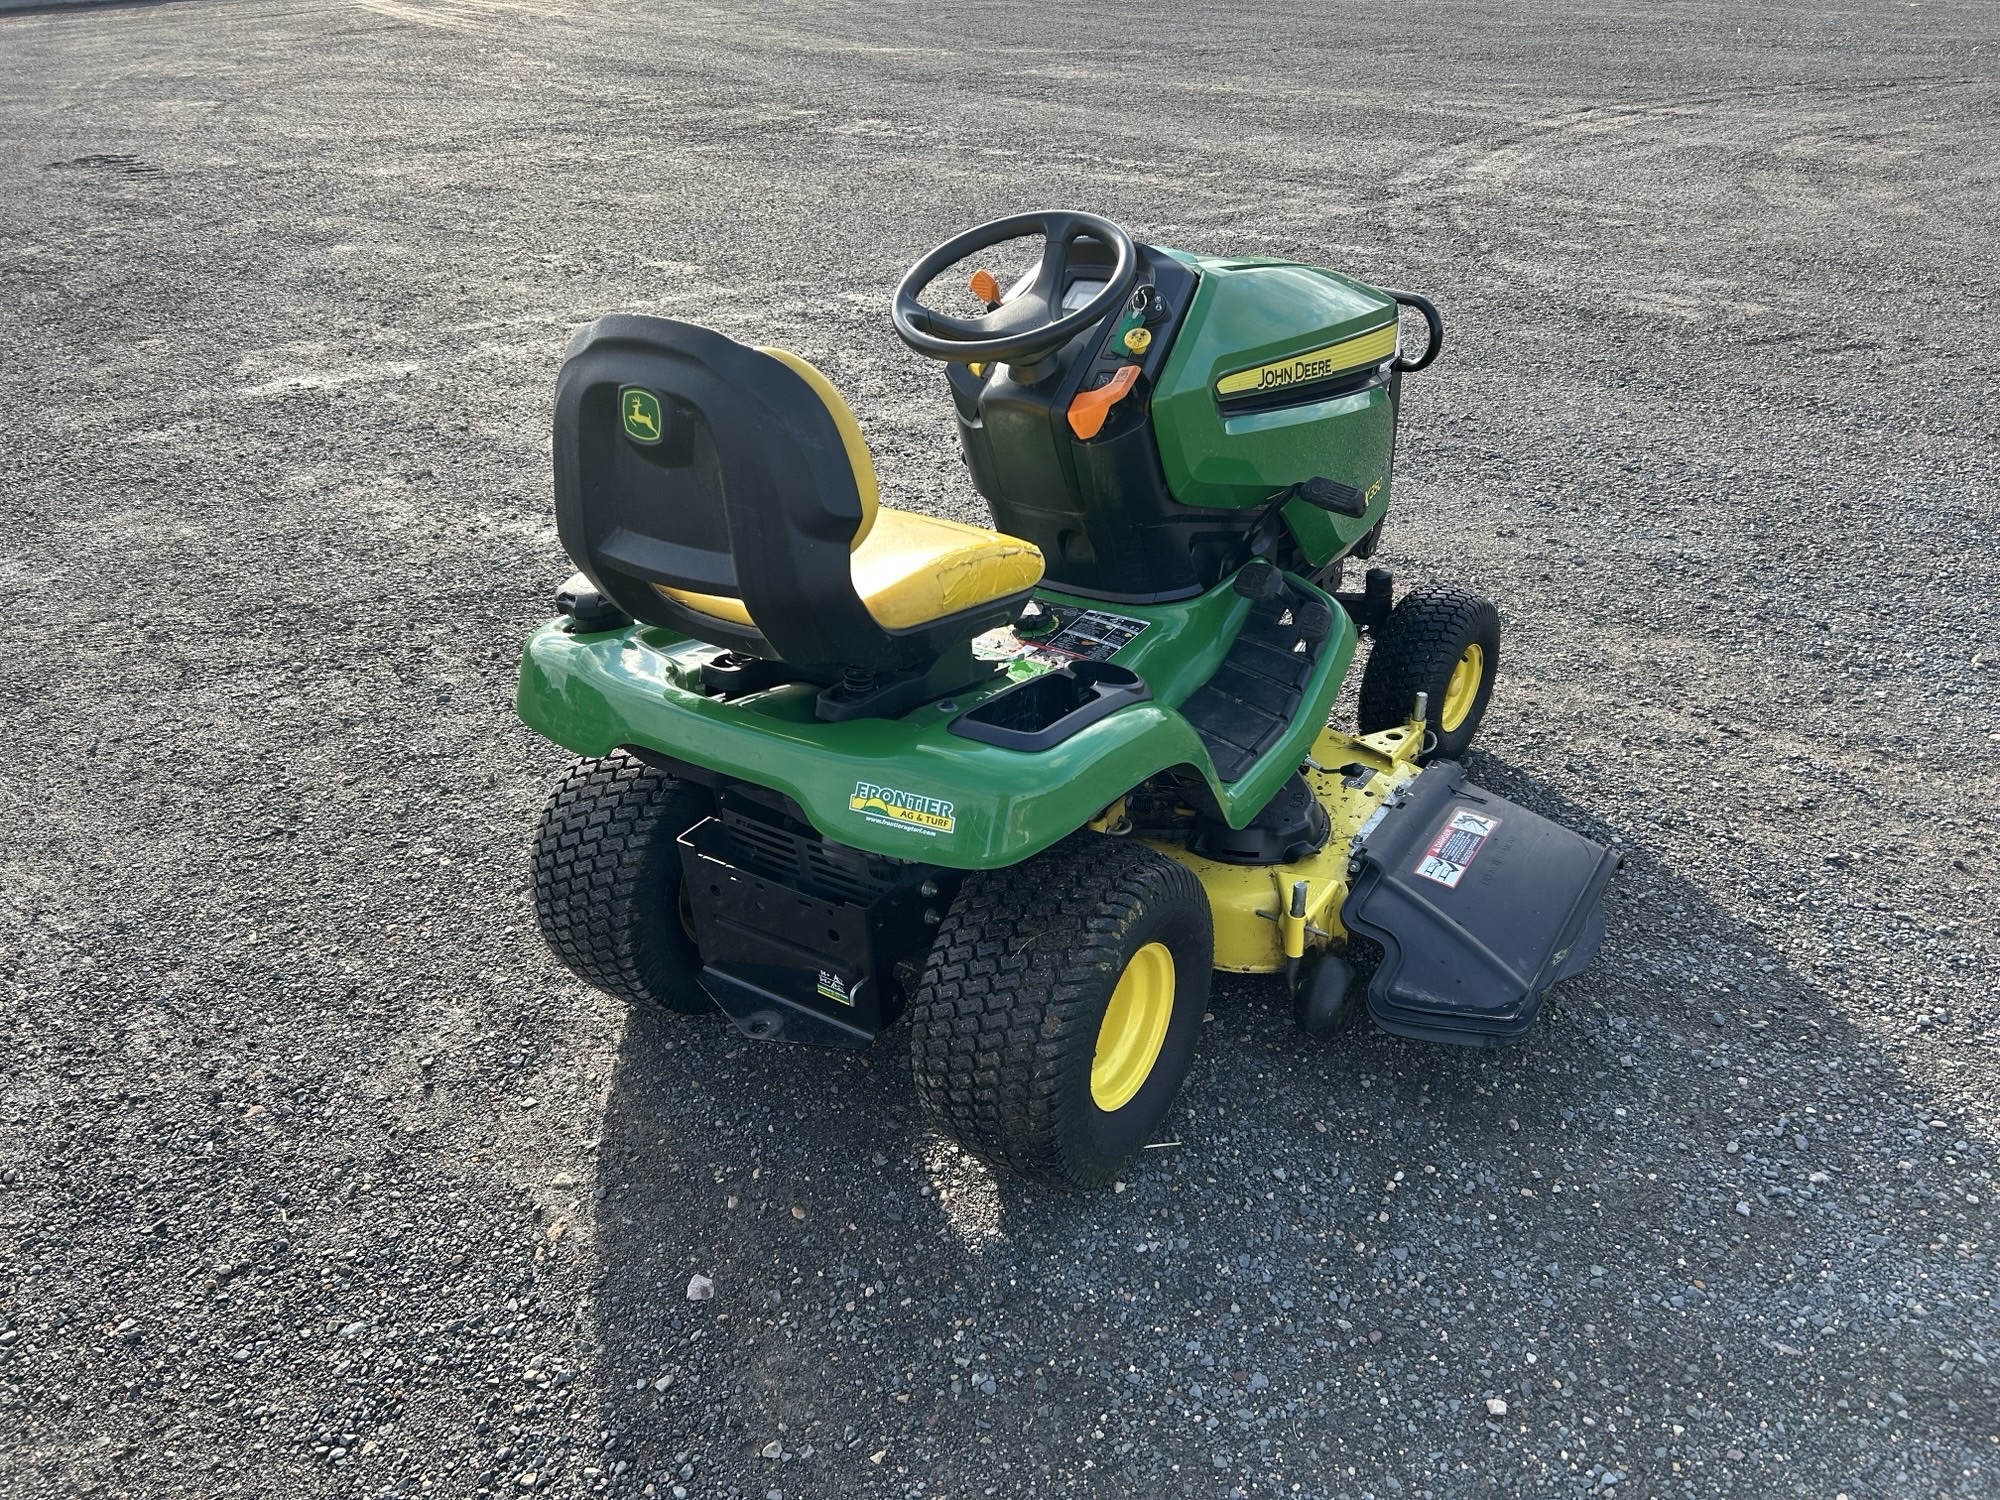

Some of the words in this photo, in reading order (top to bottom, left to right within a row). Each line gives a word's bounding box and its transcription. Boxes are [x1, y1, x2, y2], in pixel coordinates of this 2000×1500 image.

[1258, 368, 1293, 388] JOHN
[1295, 359, 1332, 380] DEERE
[855, 782, 954, 818] FRONTIER
[865, 816, 936, 837] www.frontieragturf.com
[900, 810, 914, 820] AG
[916, 814, 923, 822] &
[926, 815, 949, 828] TURF
